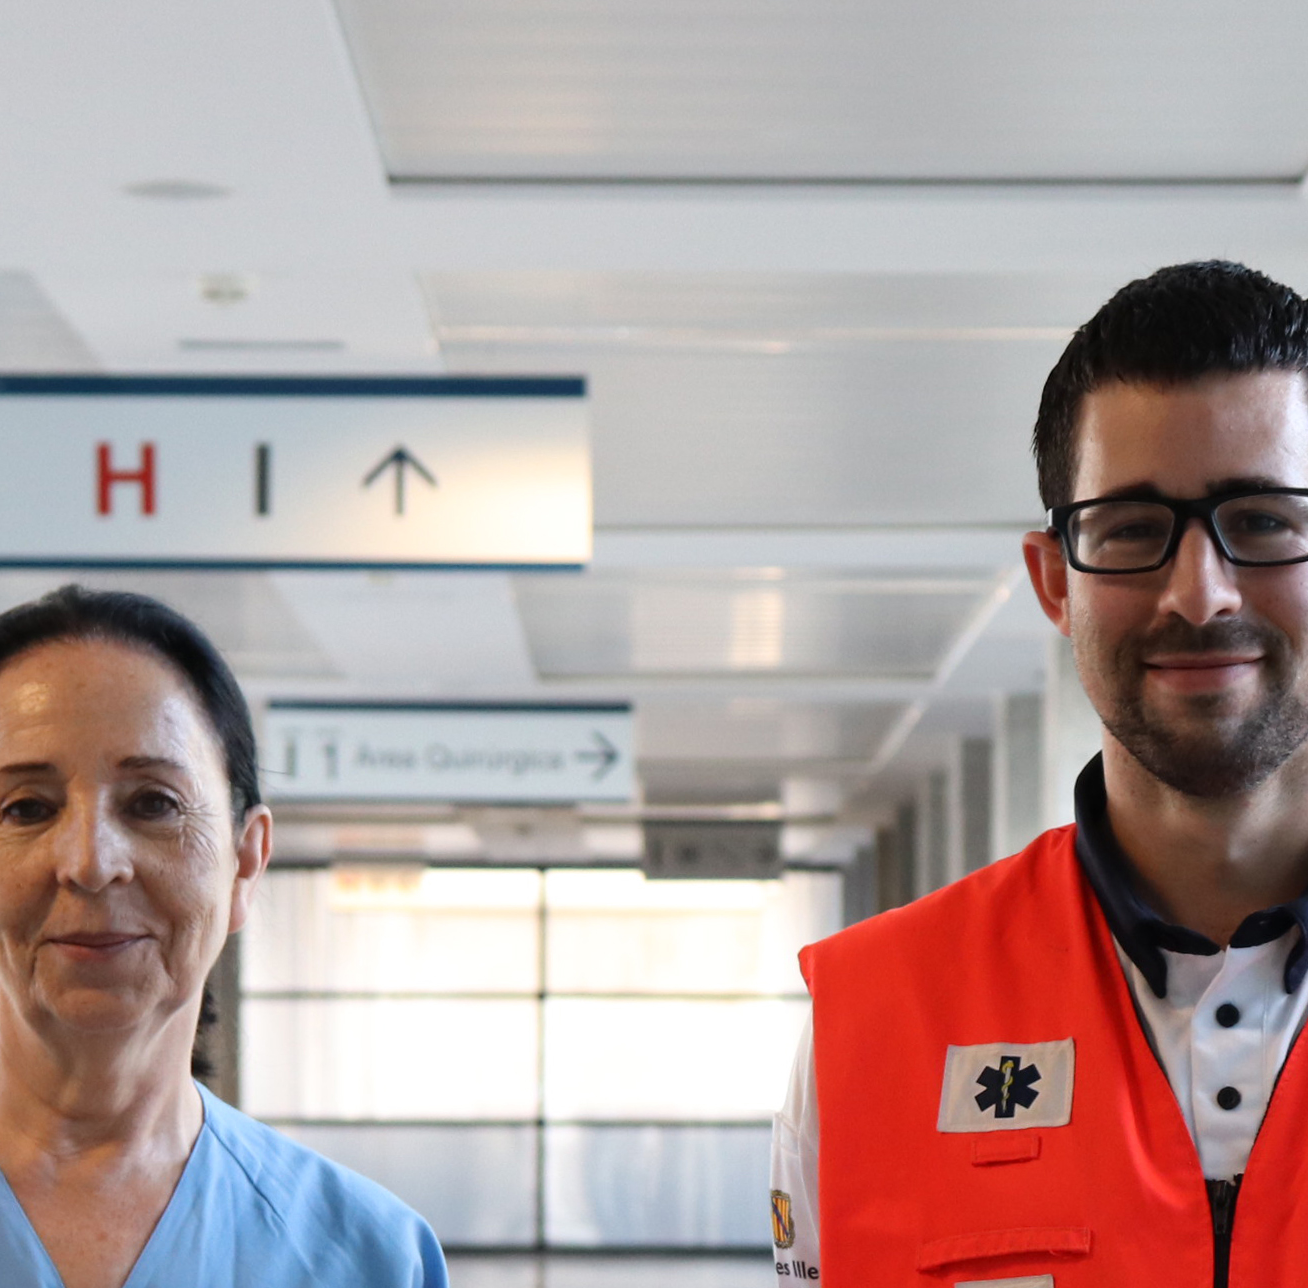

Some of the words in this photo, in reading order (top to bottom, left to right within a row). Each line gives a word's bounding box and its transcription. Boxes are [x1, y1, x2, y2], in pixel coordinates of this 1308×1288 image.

[96, 441, 156, 517] H
[254, 441, 272, 517] I
[775, 1260, 791, 1275] es
[792, 1259, 820, 1280] Ille
